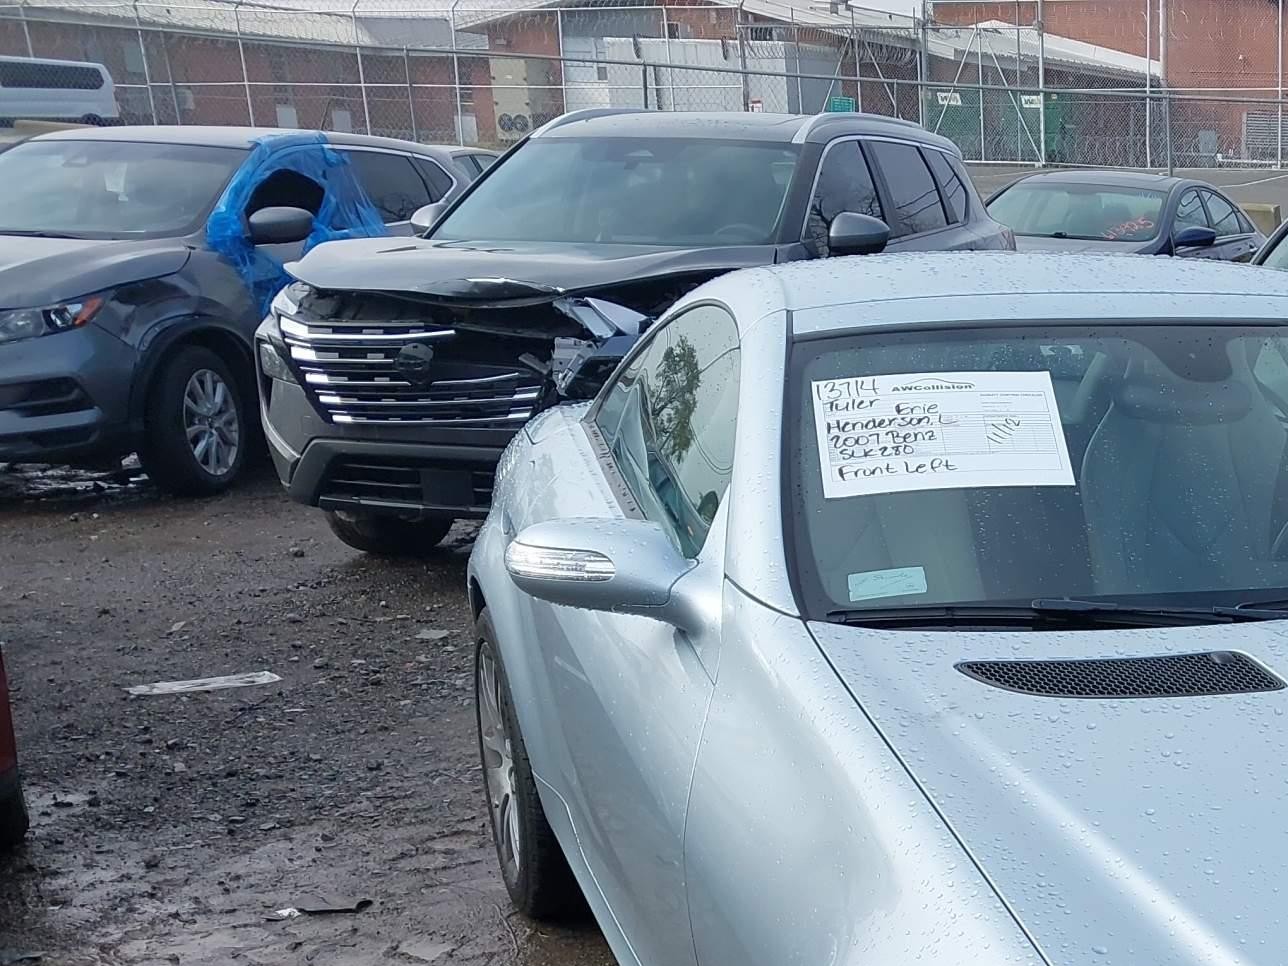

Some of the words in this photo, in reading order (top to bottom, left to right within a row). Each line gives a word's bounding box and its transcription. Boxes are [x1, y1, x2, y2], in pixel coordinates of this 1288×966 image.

[891, 383, 972, 393] AWCollision
[830, 433, 880, 449] 2007
[885, 430, 937, 444] Benz
[838, 464, 898, 481] Front
[904, 458, 959, 474] Left
